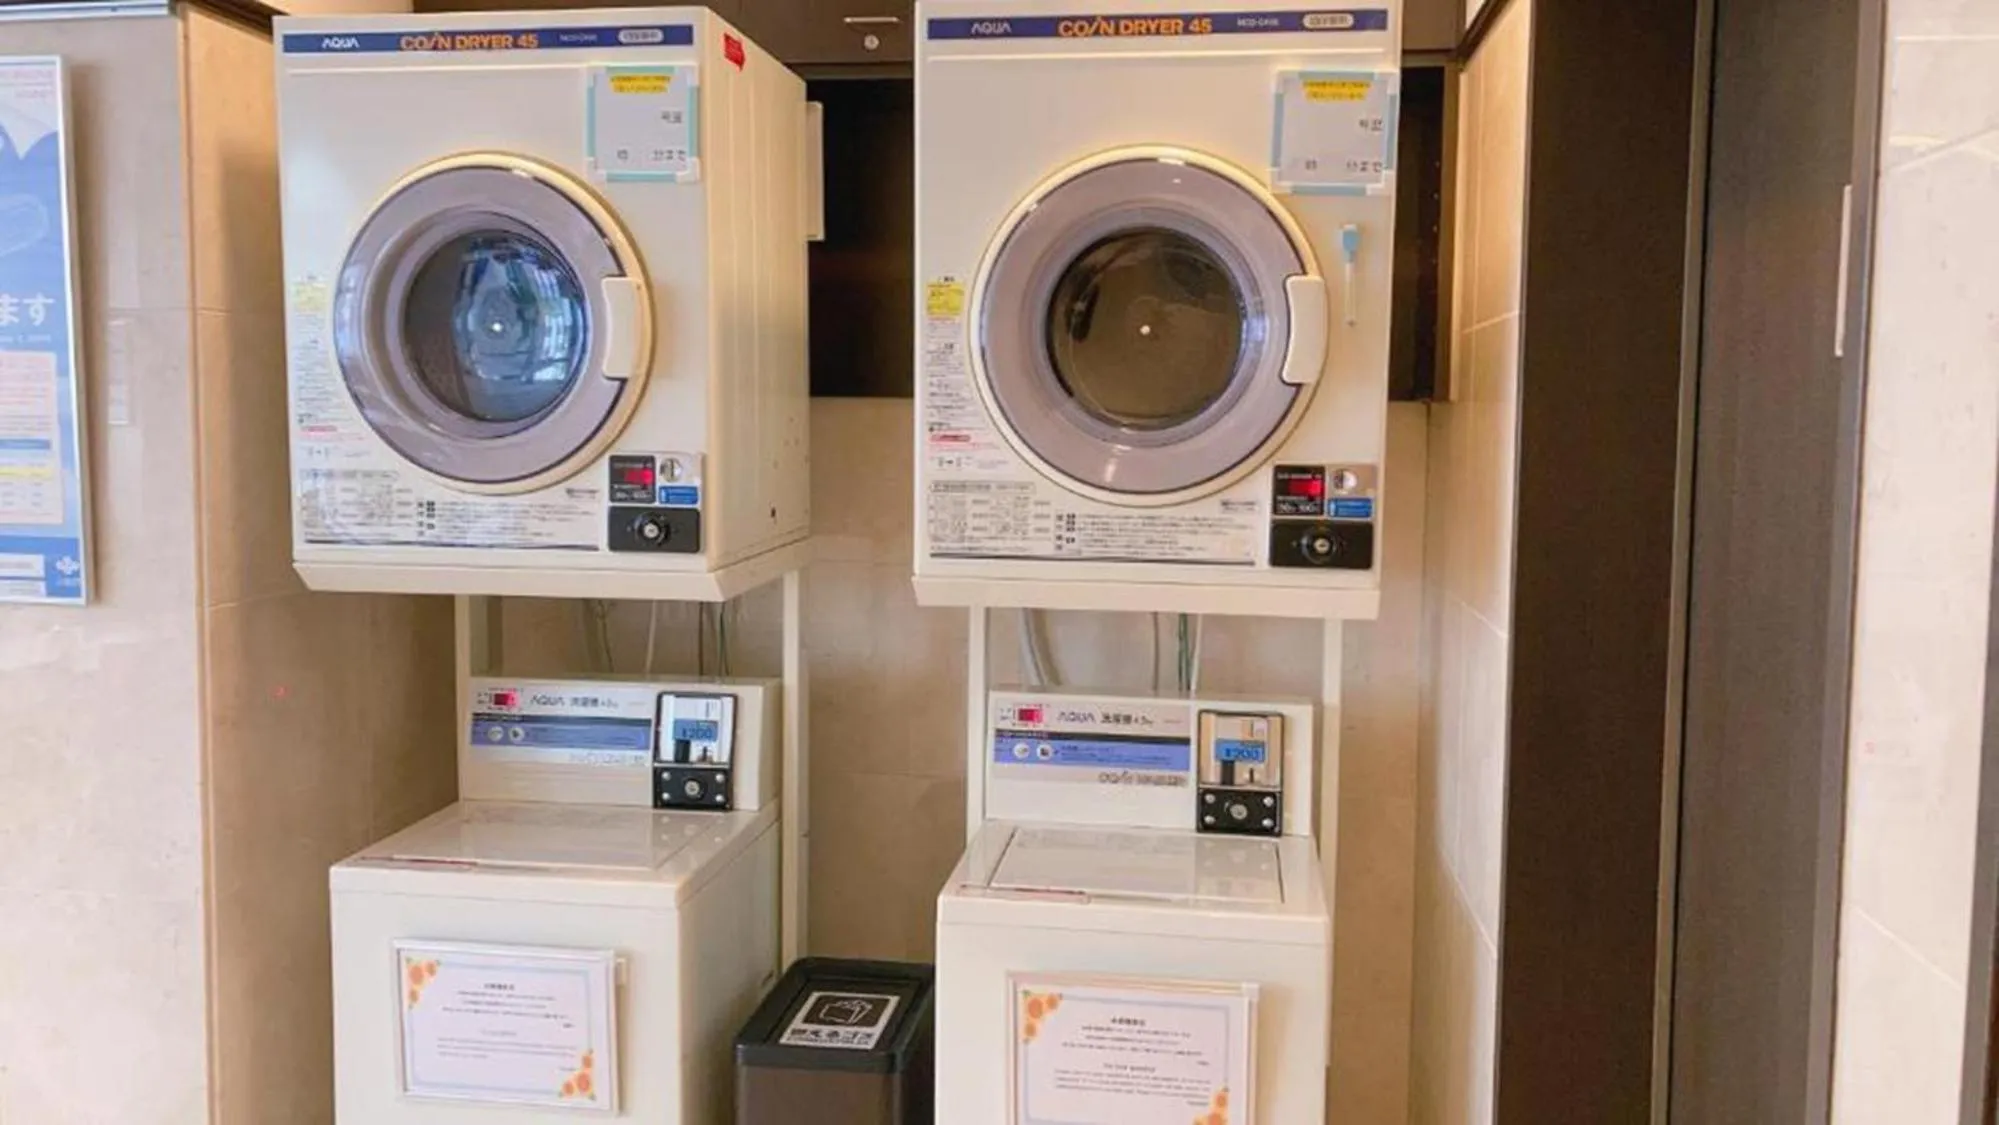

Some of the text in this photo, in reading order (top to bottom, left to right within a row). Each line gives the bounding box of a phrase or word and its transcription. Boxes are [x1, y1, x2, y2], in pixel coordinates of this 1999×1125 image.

[971, 21, 1011, 34] AQUA
[1120, 18, 1183, 35] DRYER
[1188, 17, 1213, 34] 45
[322, 36, 360, 49] AQUA
[456, 33, 513, 50] DRYER
[517, 33, 539, 49] 45
[0, 292, 56, 327] ます
[530, 693, 565, 706] AQUA
[1056, 710, 1096, 724] AQUA
